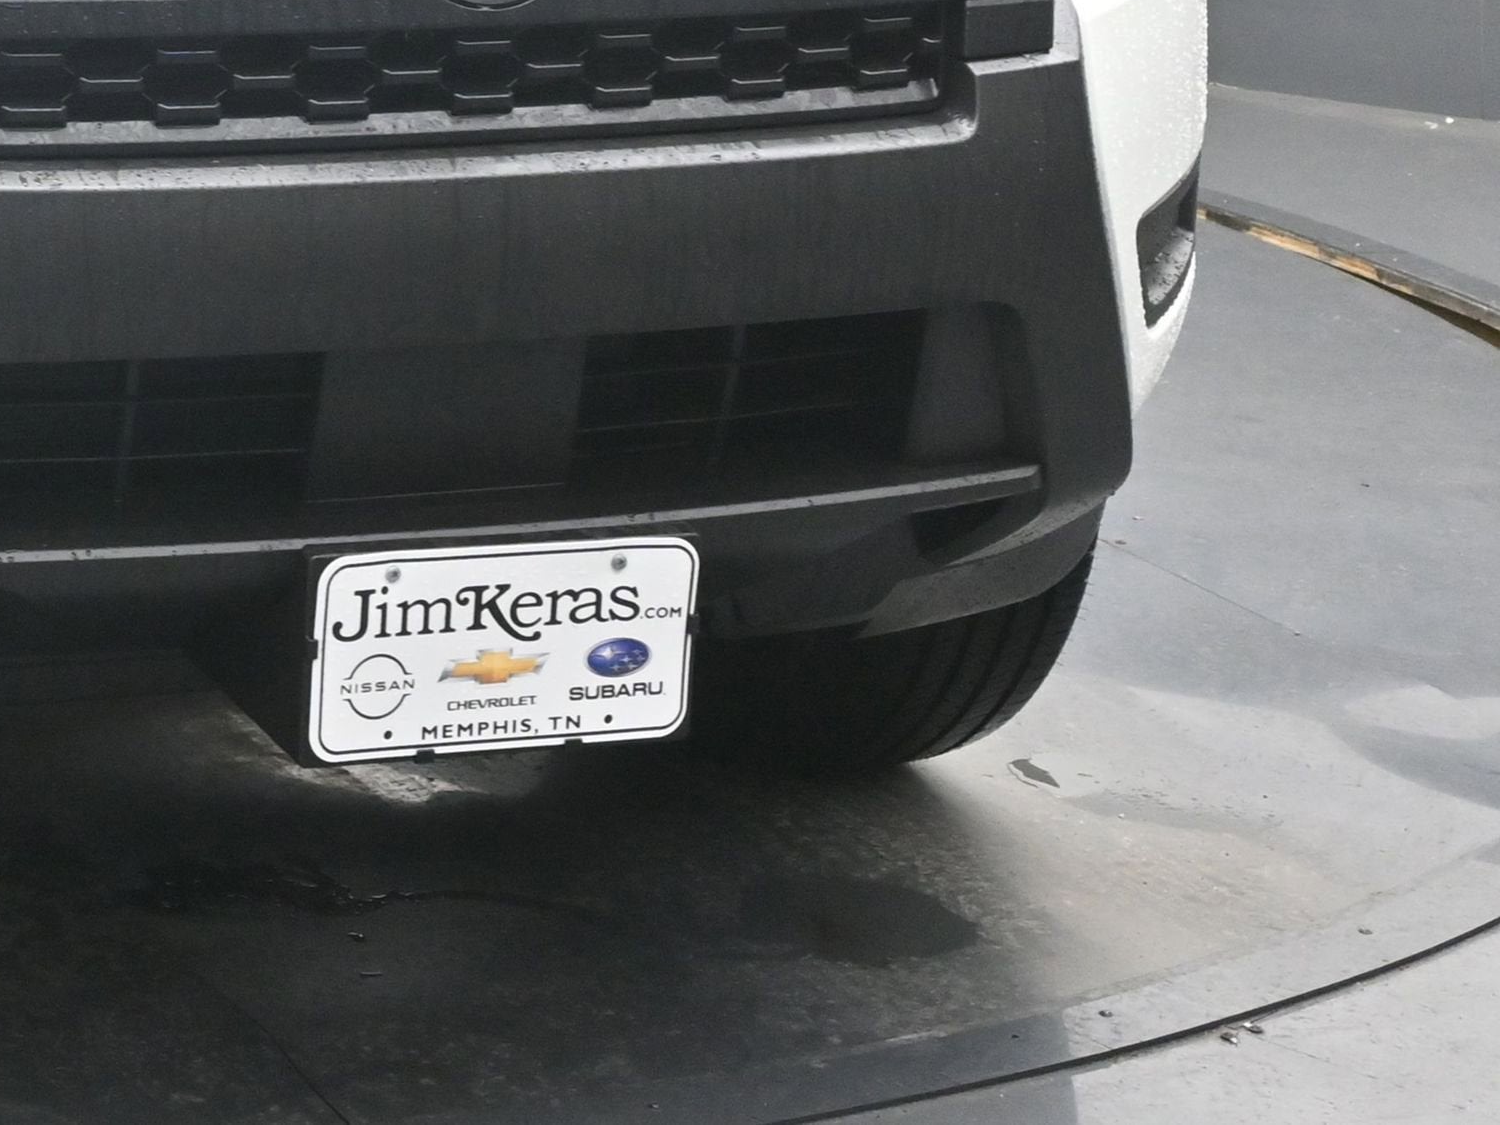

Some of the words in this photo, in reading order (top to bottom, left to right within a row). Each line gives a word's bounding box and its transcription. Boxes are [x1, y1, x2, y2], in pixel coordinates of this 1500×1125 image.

[339, 678, 416, 695] NISSAN
[568, 681, 664, 701] SUBARU
[446, 696, 537, 711] CHEVROLET
[421, 719, 539, 740] MEMPHIS,
[549, 715, 581, 730] TN
